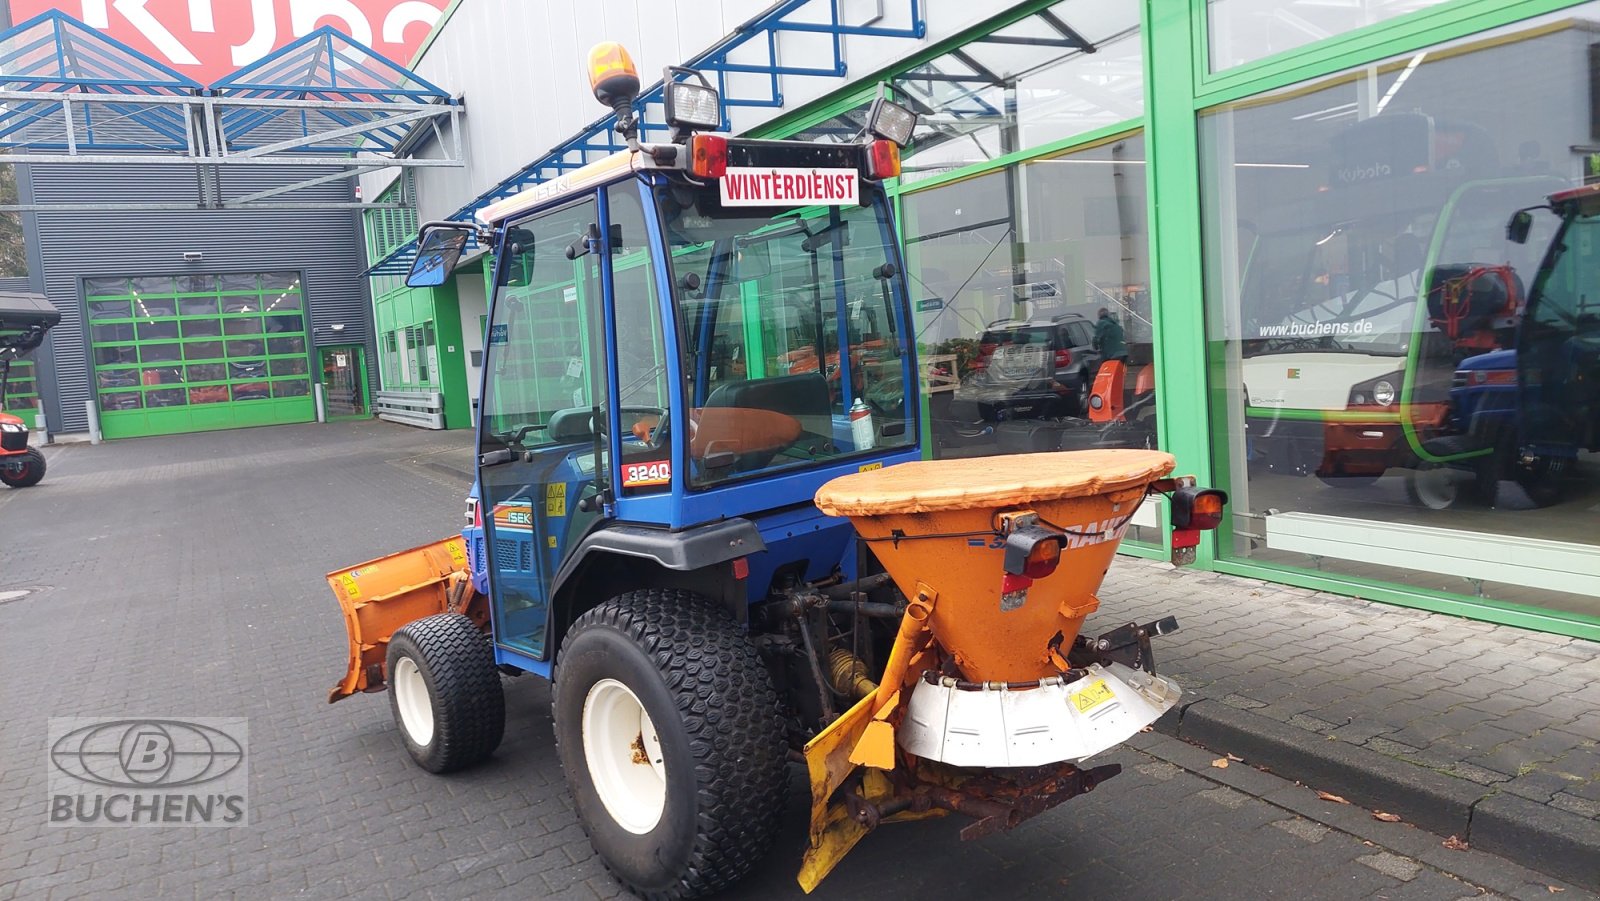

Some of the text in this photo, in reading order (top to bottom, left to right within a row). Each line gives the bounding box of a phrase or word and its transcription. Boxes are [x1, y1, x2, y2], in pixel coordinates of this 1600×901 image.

[725, 174, 855, 200] WINTERDIENST
[1259, 319, 1373, 336] www.buchens.de
[628, 463, 669, 482] 3240
[508, 512, 532, 524] ISEK
